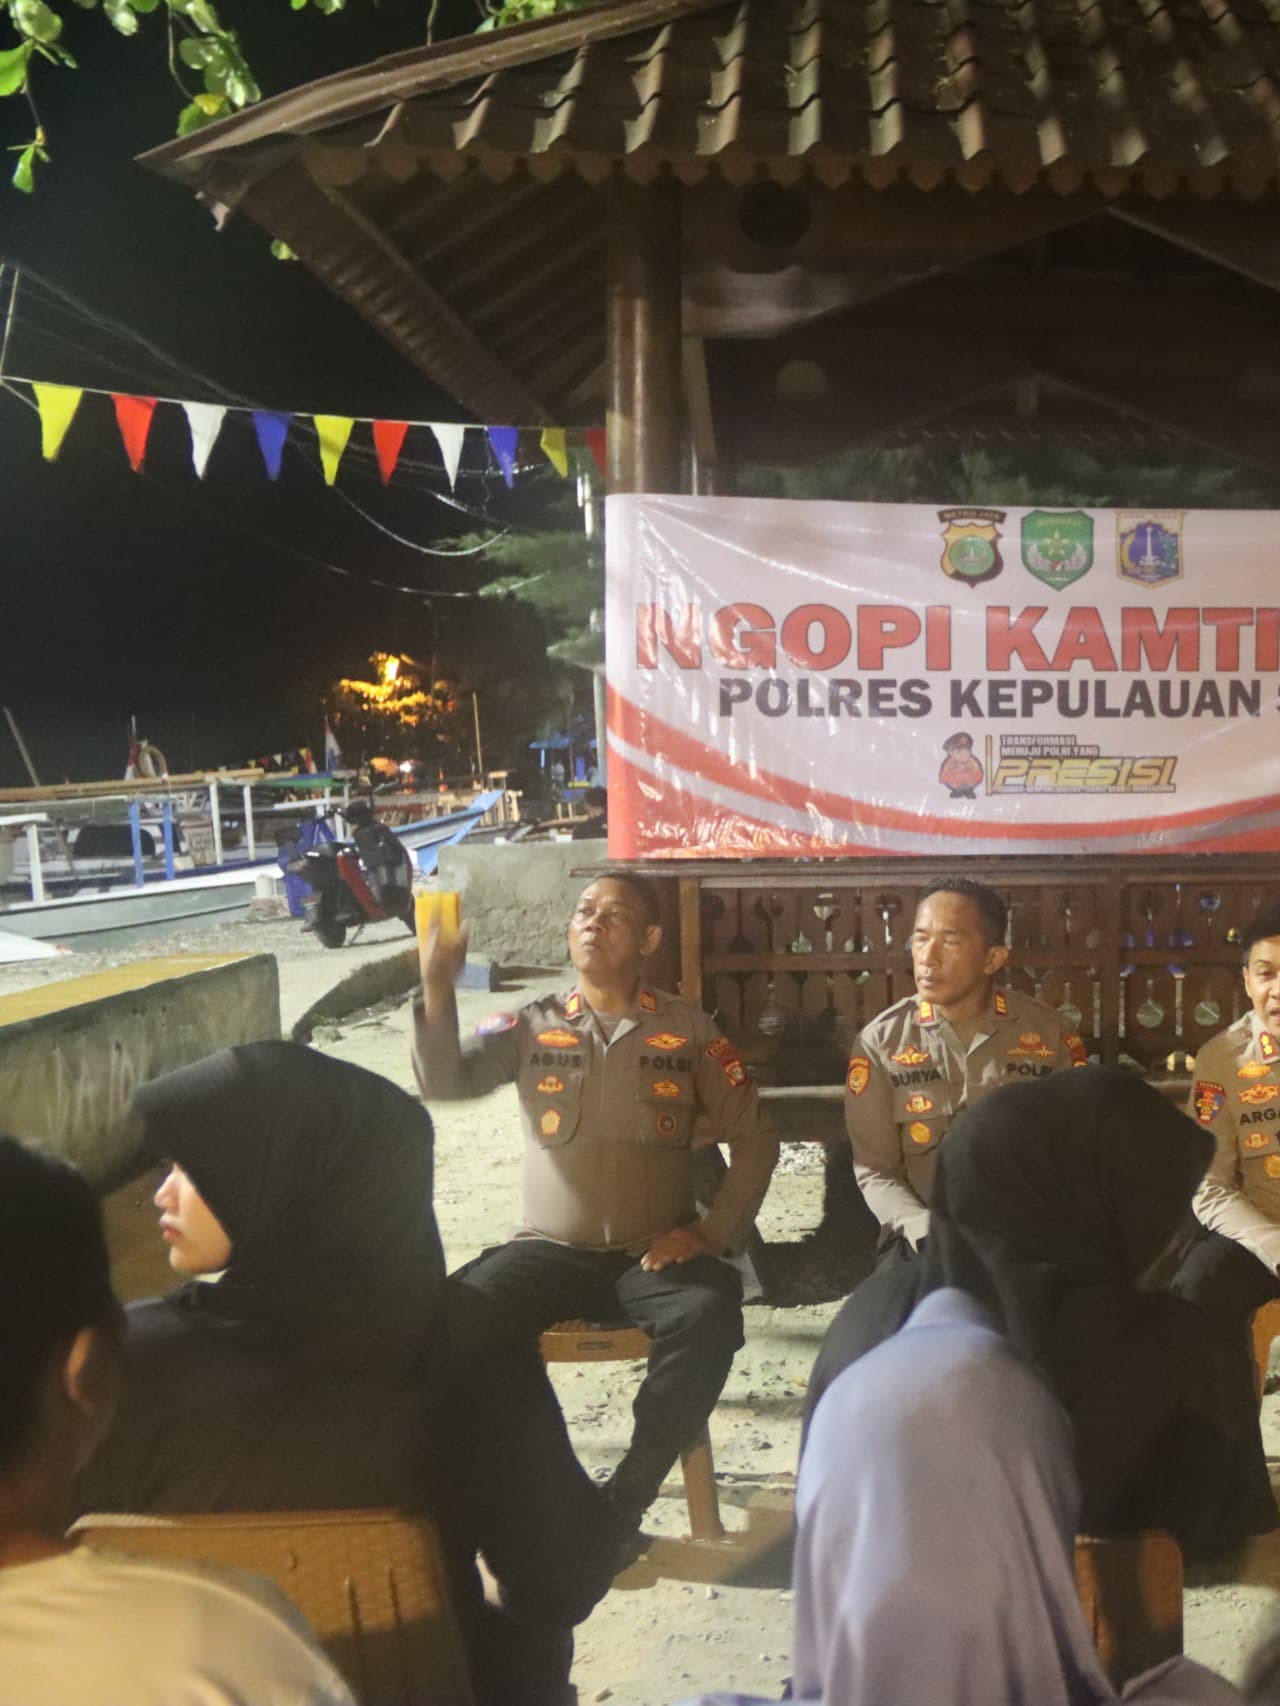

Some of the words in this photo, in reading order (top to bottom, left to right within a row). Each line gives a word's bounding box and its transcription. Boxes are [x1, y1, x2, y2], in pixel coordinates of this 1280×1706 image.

[636, 603, 953, 671] NGOPI
[719, 678, 933, 719] POLRES
[949, 678, 1261, 719] KEPULAUAN
[1001, 735, 1075, 746] TRANSFORMASI
[992, 756, 1177, 786] PRESISI
[530, 1052, 583, 1068] AGUS
[639, 1055, 693, 1072] POLRI
[892, 1067, 942, 1088] SURYA
